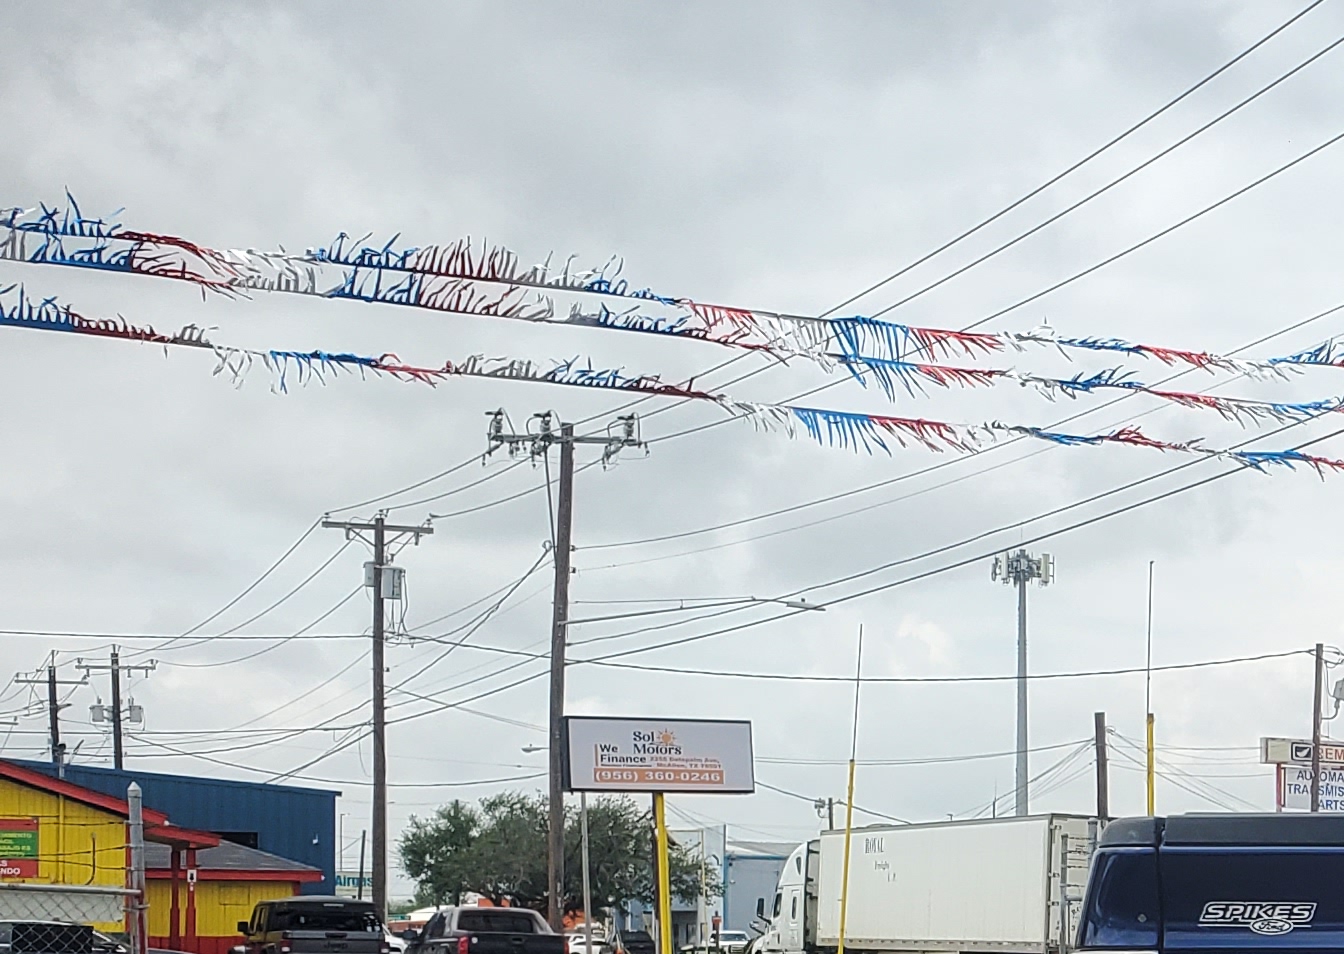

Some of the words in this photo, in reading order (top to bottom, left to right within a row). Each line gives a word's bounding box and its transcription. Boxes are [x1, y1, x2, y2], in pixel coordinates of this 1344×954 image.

[633, 731, 654, 742] Sol
[600, 743, 618, 753] We
[633, 743, 682, 755] Motors
[600, 754, 647, 763] Finance
[595, 771, 638, 783] (956)
[645, 771, 720, 781] 360-0246
[1204, 904, 1312, 919] SPIKES
